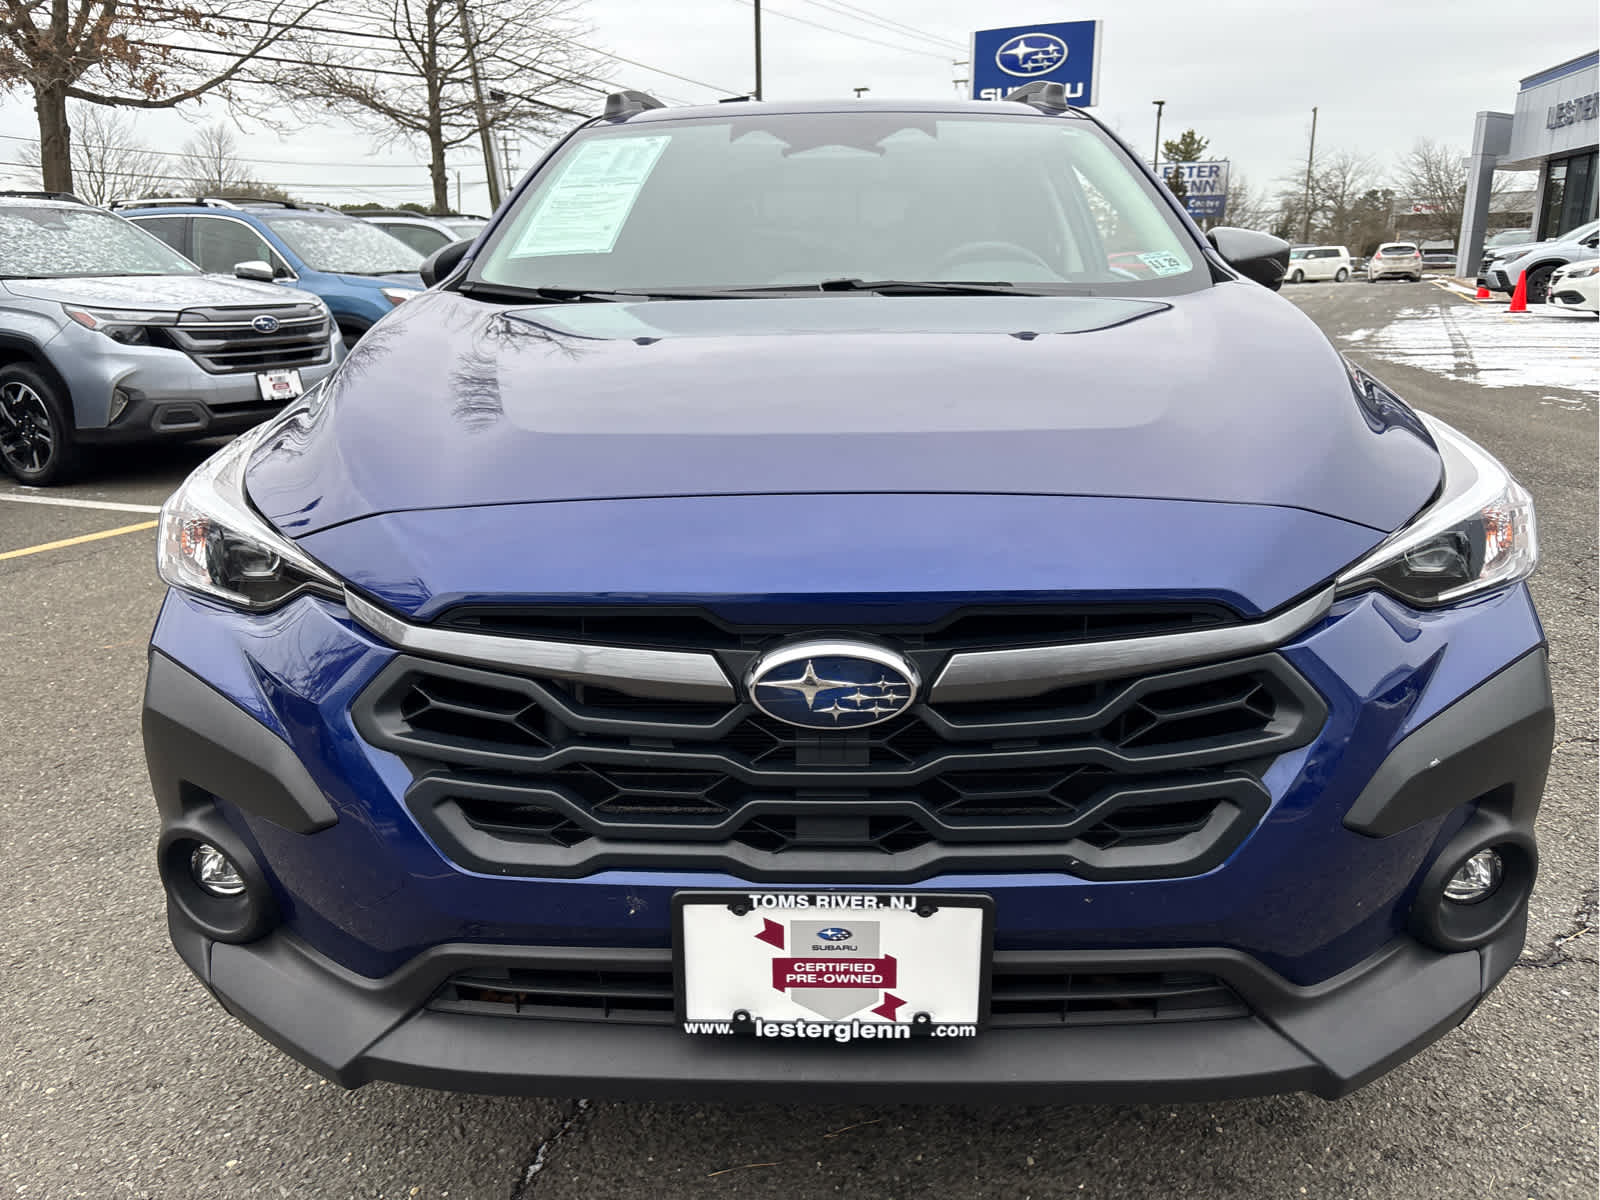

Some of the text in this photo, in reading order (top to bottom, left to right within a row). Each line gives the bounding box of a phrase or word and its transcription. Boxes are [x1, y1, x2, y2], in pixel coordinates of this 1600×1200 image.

[748, 894, 809, 909] TOMS
[890, 896, 917, 911] NJ
[811, 944, 858, 952] SUBARU
[793, 962, 876, 973] CERTIFIED
[786, 974, 883, 984] PRE-OWNED
[684, 1019, 976, 1043] www. lesterglenn .com
